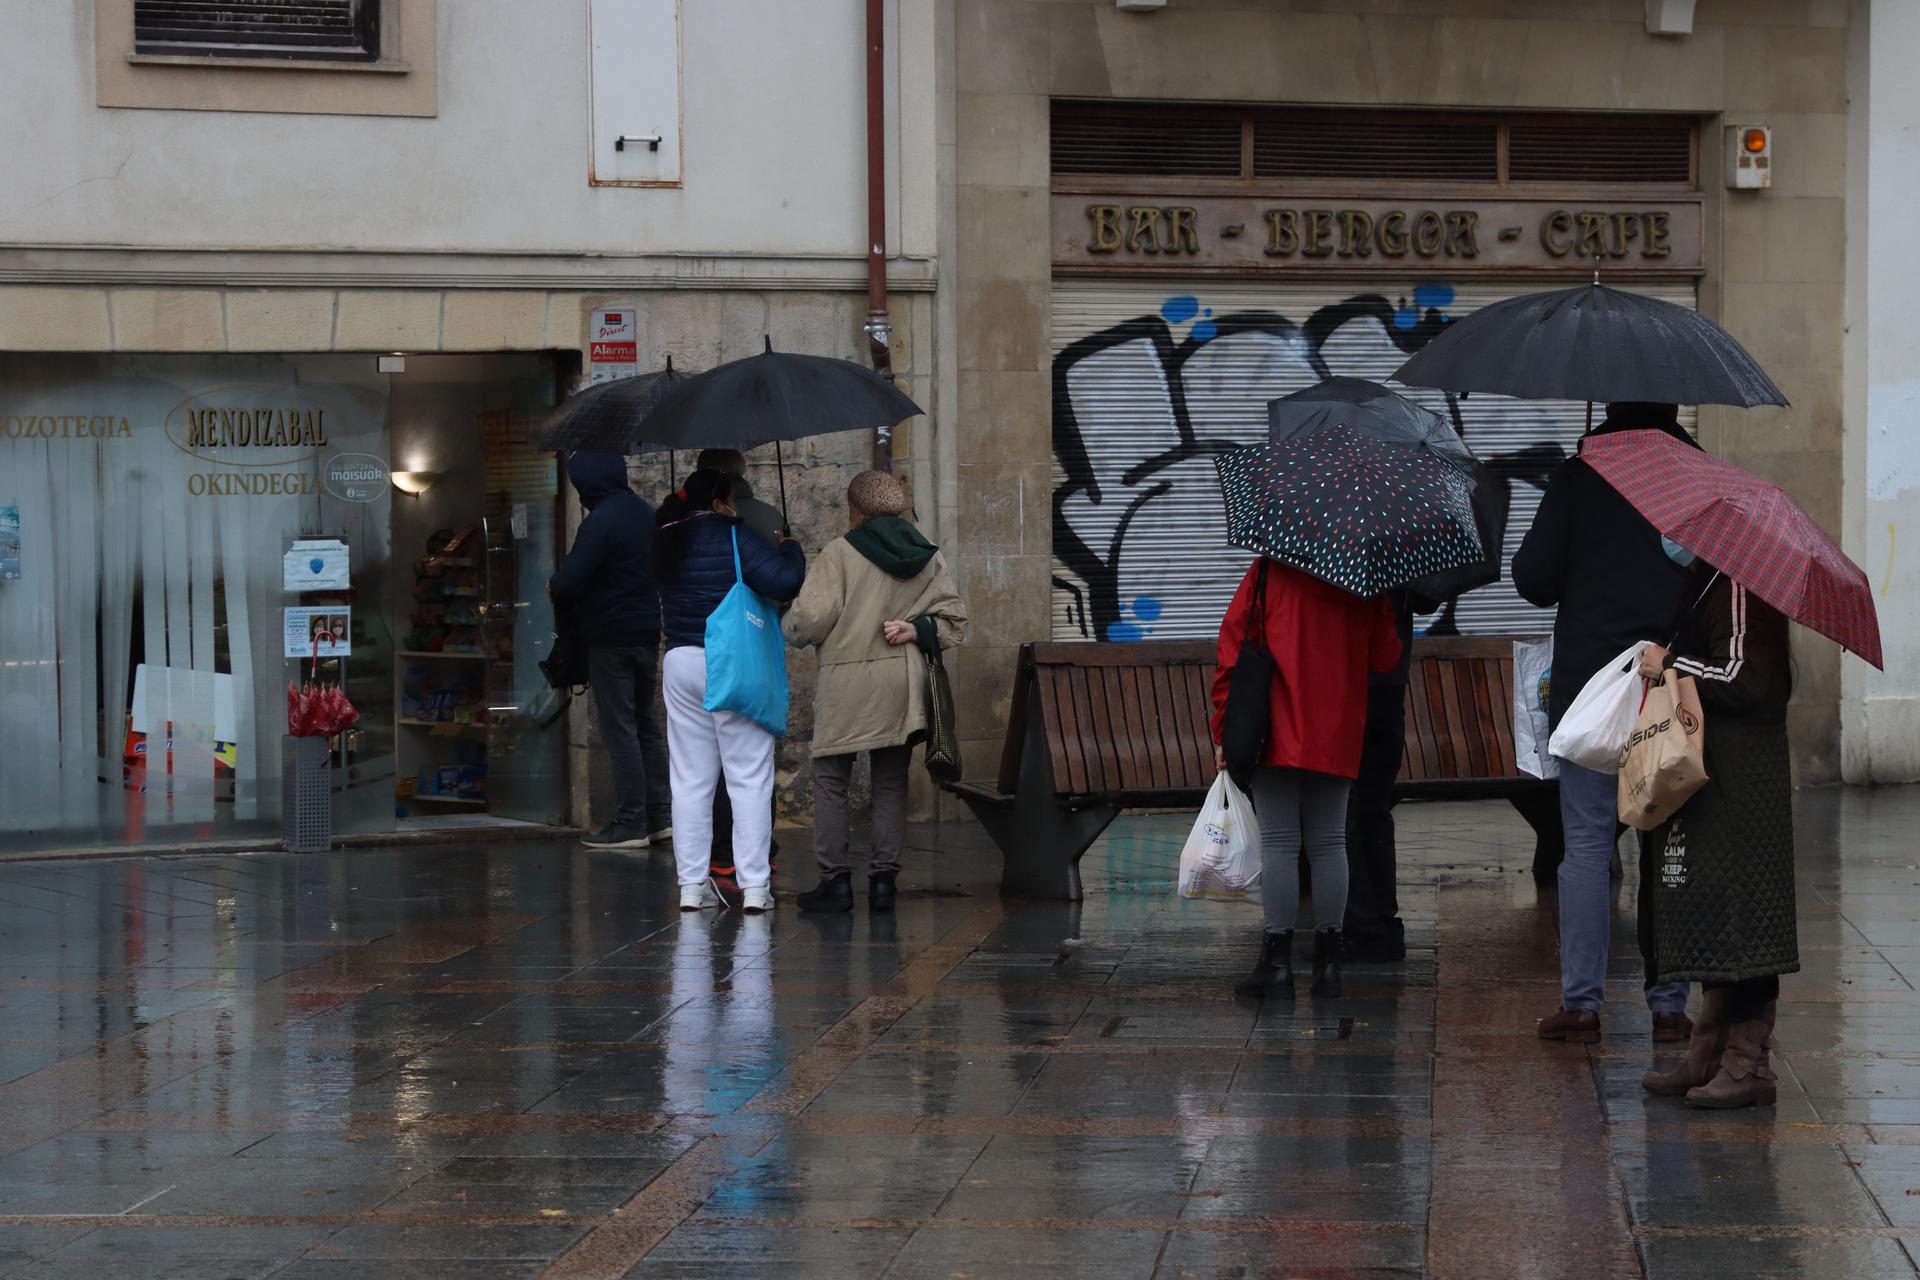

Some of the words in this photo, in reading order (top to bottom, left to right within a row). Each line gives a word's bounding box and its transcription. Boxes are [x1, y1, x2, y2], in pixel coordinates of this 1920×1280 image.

[1087, 205, 1200, 254] BAR
[1264, 207, 1480, 257] BENGOA
[1540, 209, 1671, 257] CAFE
[593, 344, 635, 354] Alarma
[0, 416, 133, 438] OZOTEGIA
[187, 408, 328, 447] MENDIZABAL
[331, 467, 382, 480] maisuak
[187, 473, 325, 496] OKINDEGIA
[1664, 846, 1686, 857] CALM
[1664, 864, 1683, 875] KEEP
